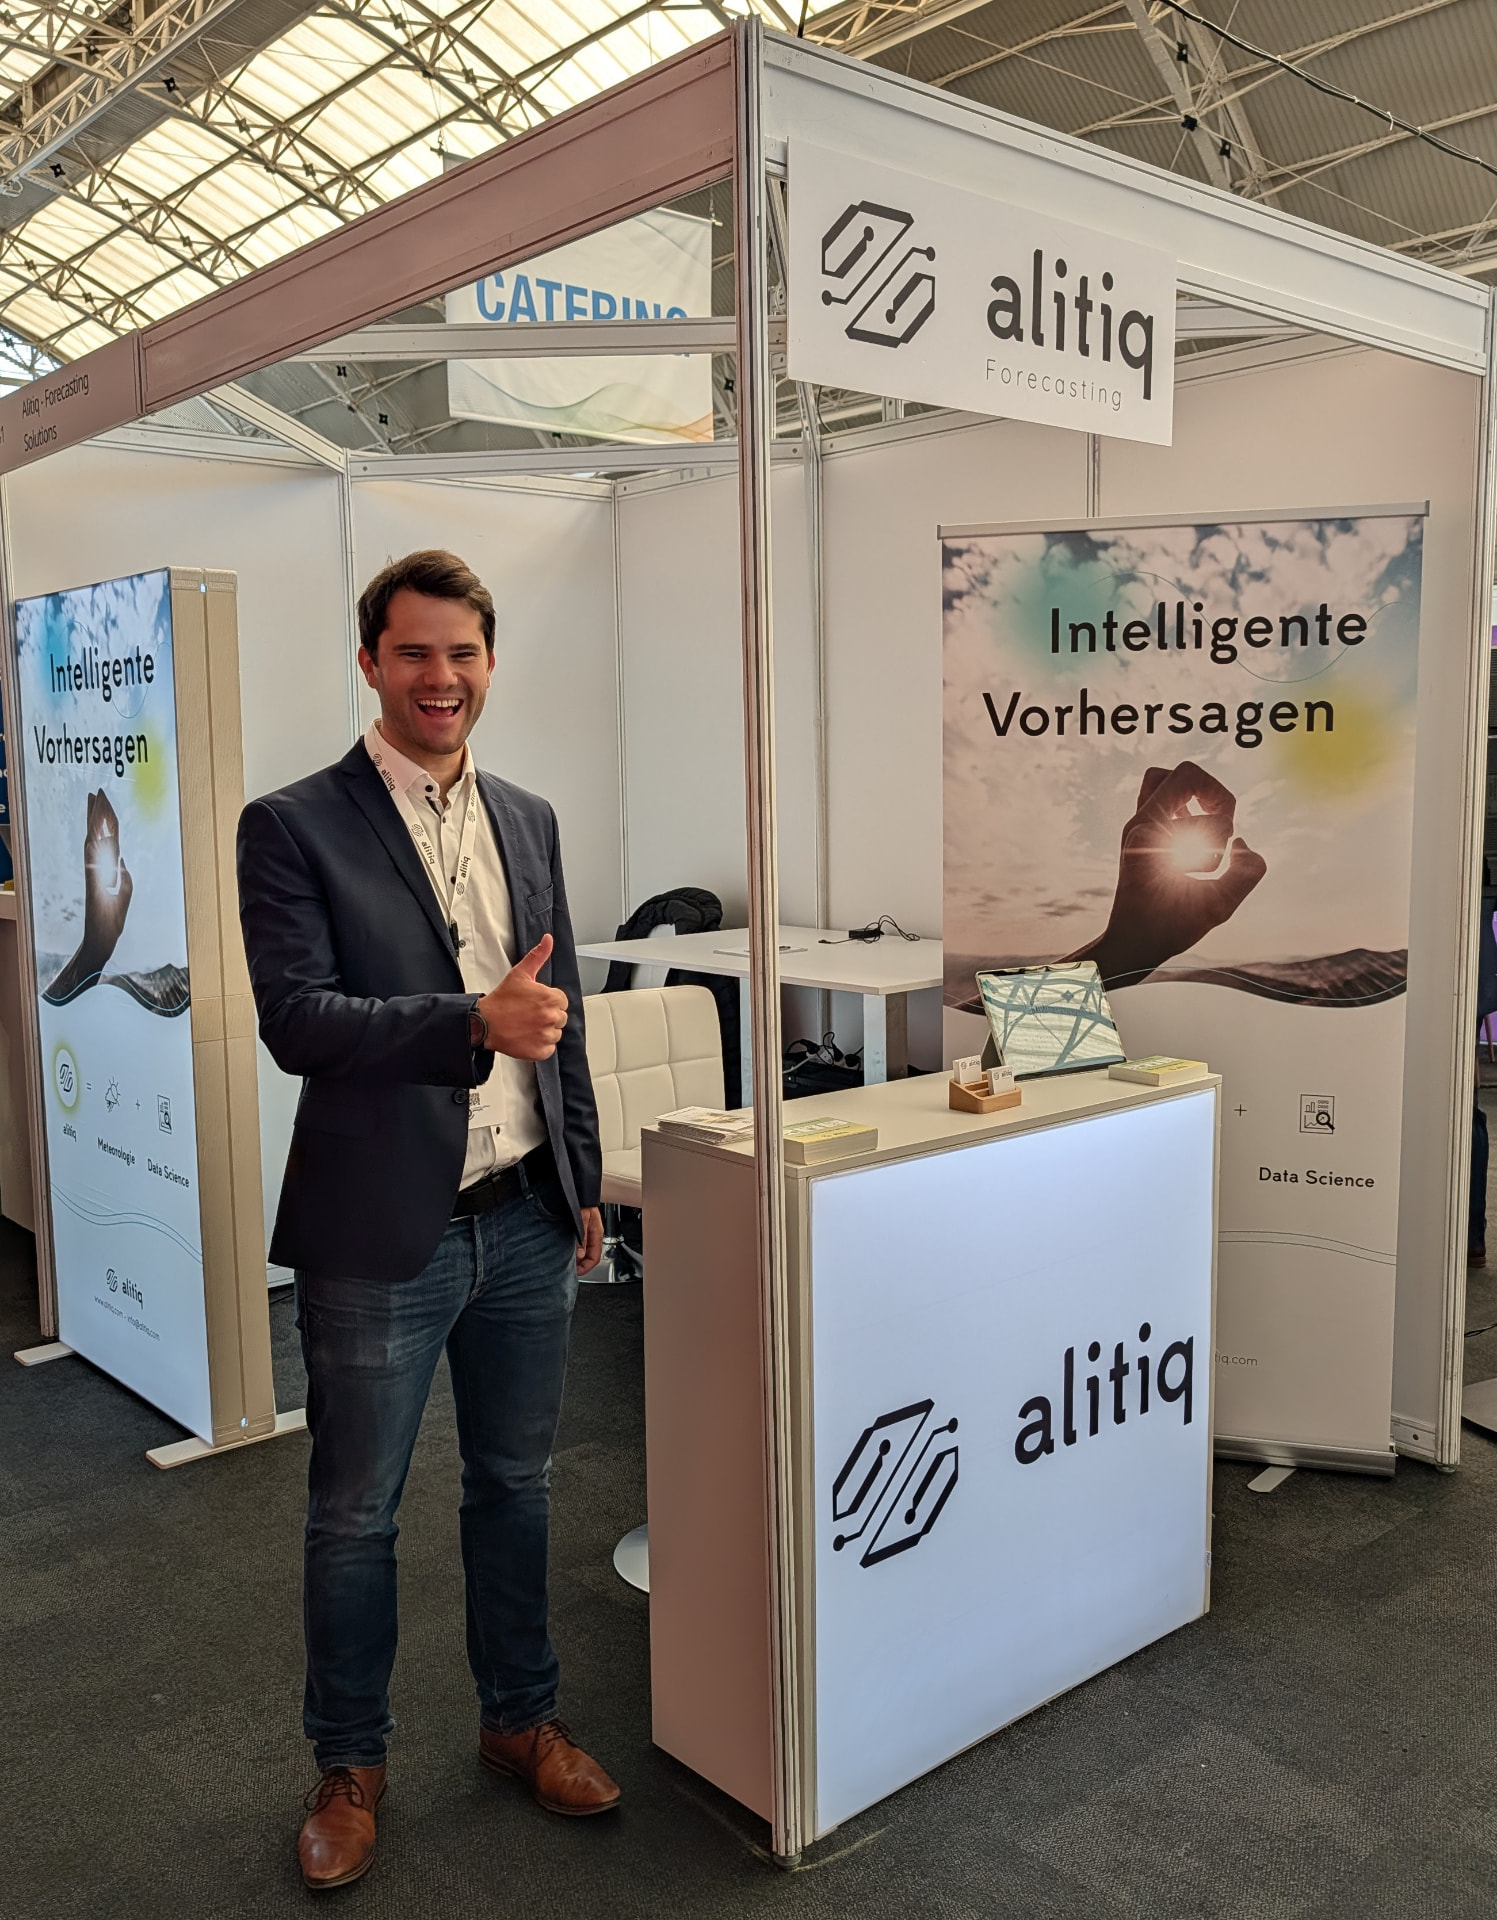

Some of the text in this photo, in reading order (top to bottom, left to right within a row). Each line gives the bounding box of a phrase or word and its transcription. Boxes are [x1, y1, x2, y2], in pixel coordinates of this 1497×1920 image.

[987, 249, 1153, 400] alitiq
[22, 395, 41, 419] Alitiq
[44, 374, 89, 408] Forecasting
[986, 358, 1122, 411] Forecasting
[23, 425, 57, 452] Solutions
[1050, 601, 1368, 665] Intelligente
[50, 645, 155, 702] Intelligente
[982, 688, 1334, 749] Vorhersagen
[34, 722, 149, 777] Vorhersagen
[381, 768, 396, 792] alitiq
[421, 841, 436, 865] alitiq
[460, 856, 471, 878] alitiq
[97, 1136, 136, 1167] Meteorologie
[147, 1158, 190, 1188] Data Science
[1259, 1167, 1375, 1188] Data Science
[122, 1277, 144, 1311] alitiq
[1214, 1350, 1258, 1366] tiq.com
[1014, 1322, 1194, 1465] alitiq
